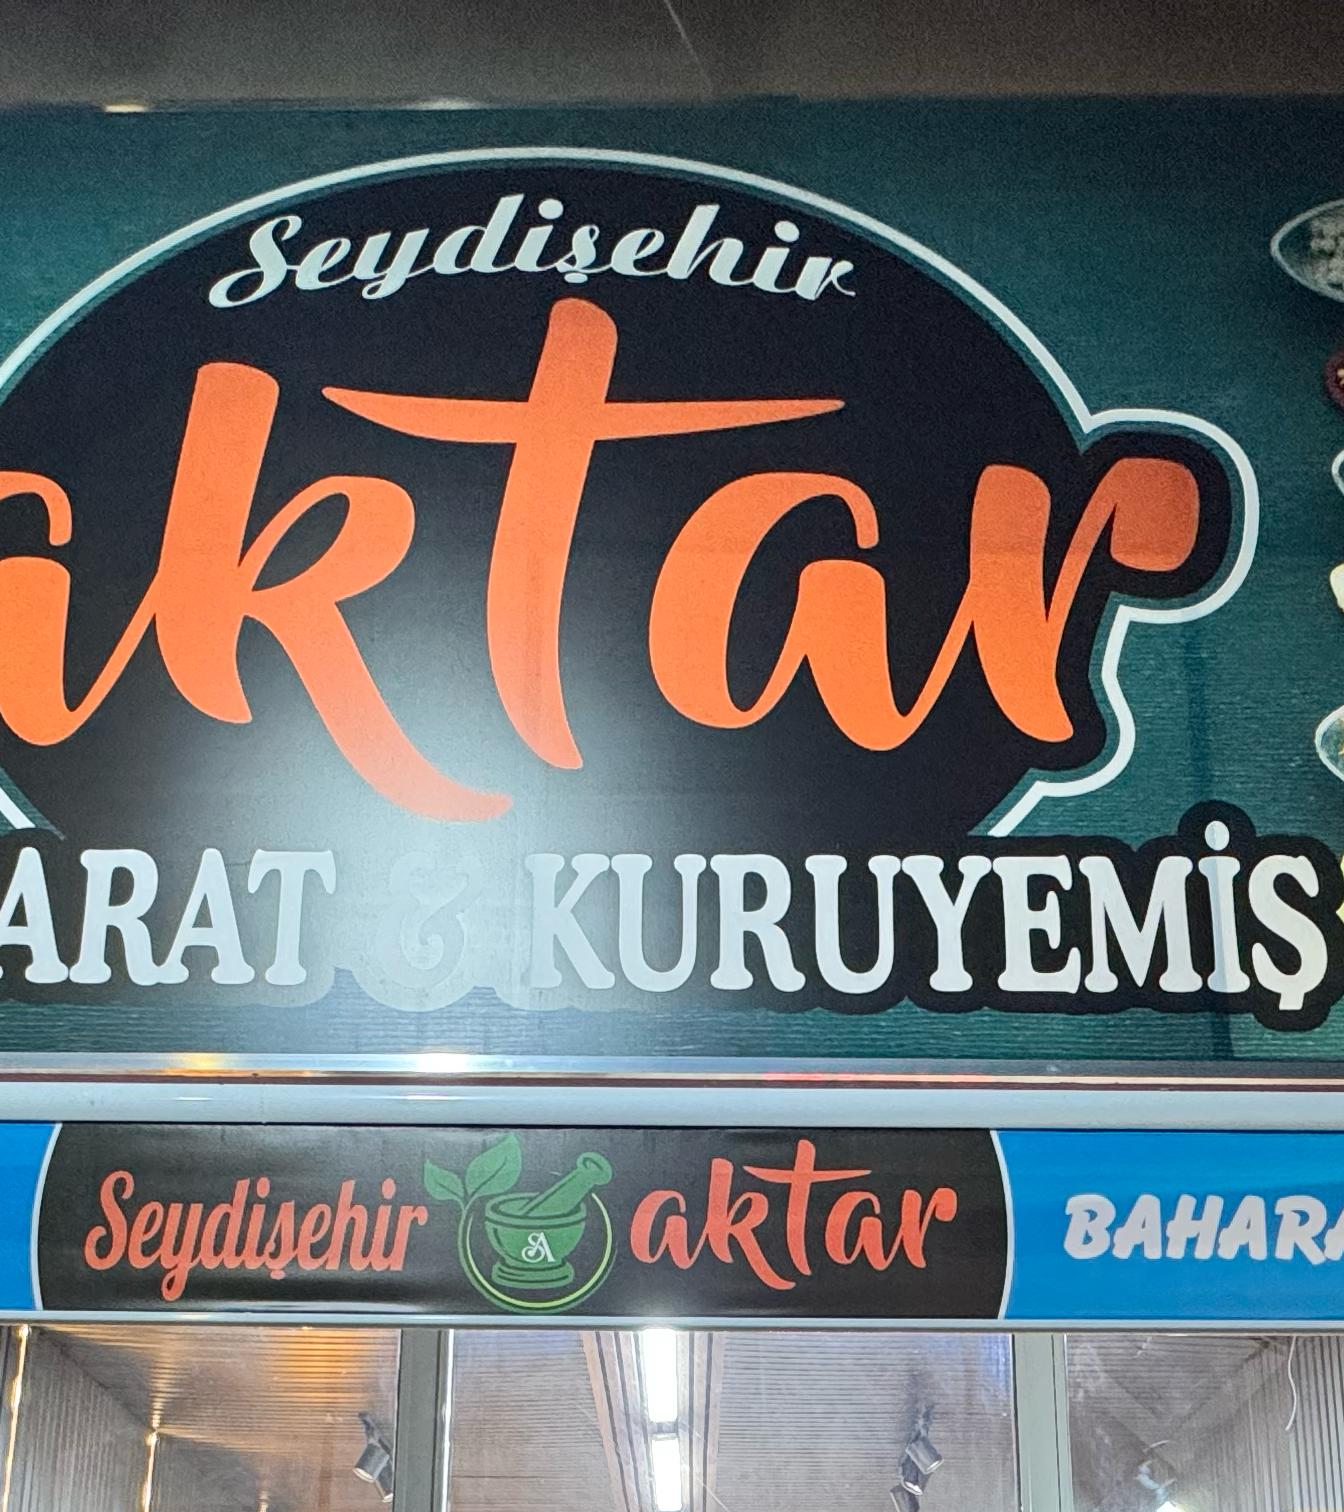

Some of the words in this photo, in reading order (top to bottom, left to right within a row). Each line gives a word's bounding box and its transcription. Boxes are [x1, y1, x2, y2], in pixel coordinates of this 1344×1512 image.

[208, 192, 857, 310] Seydişehir
[522, 817, 1329, 1010] KURUYEMİŞ
[84, 1169, 429, 1302] Seydişehir
[629, 1138, 959, 1291] aktar
